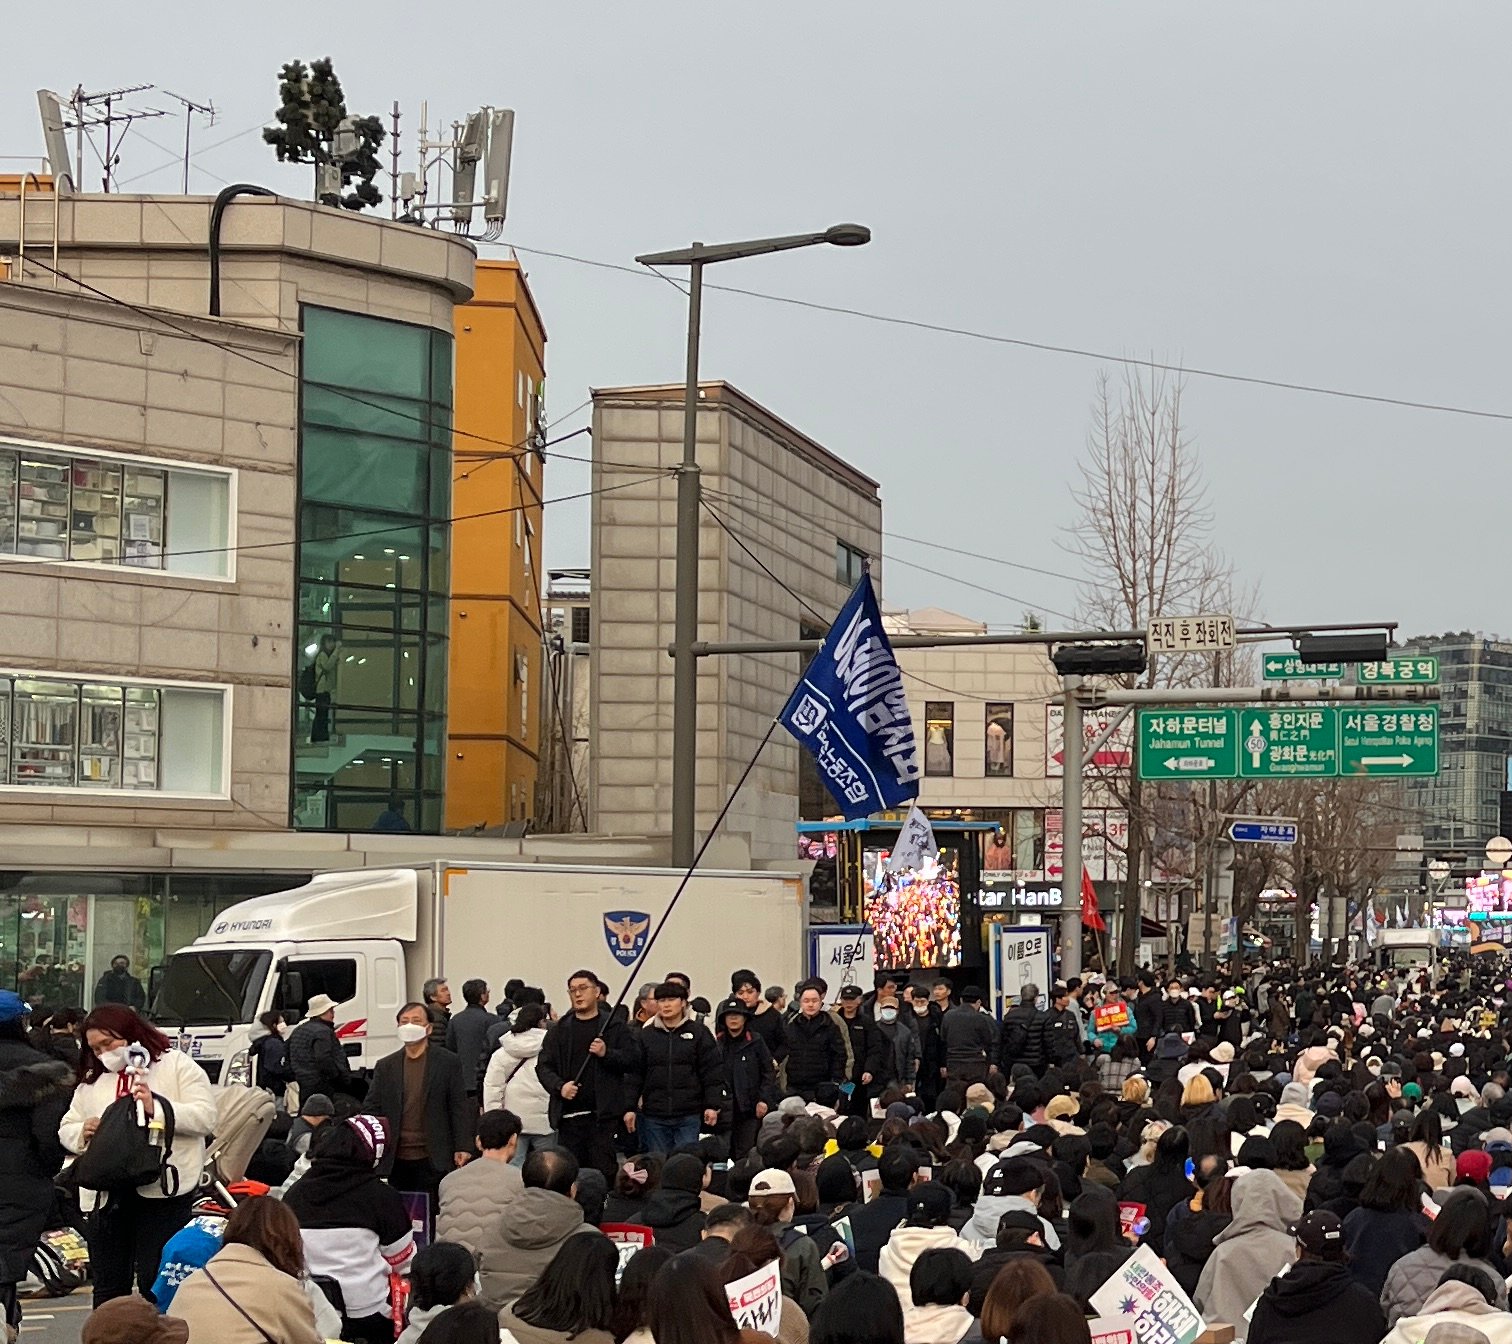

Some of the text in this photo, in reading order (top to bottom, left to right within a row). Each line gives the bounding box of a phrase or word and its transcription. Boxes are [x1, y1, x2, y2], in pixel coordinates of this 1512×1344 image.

[1150, 619, 1234, 649] 직진 후 좌회전
[1362, 661, 1434, 680] 경복궁역
[1148, 717, 1228, 735] 자하문터널
[1268, 712, 1324, 729] 흥인지문
[1345, 714, 1434, 733] 서울경찰청
[1149, 737, 1225, 750] Jahamun Tunnel
[1250, 738, 1263, 750] 50
[1269, 745, 1308, 762] 광화문
[1108, 823, 1128, 837] 3F
[968, 888, 1007, 906] tar
[229, 919, 273, 932] HYUNDAI
[615, 949, 637, 957] POLICE
[829, 941, 866, 966] 서울의
[1151, 1289, 1199, 1340] 해체
